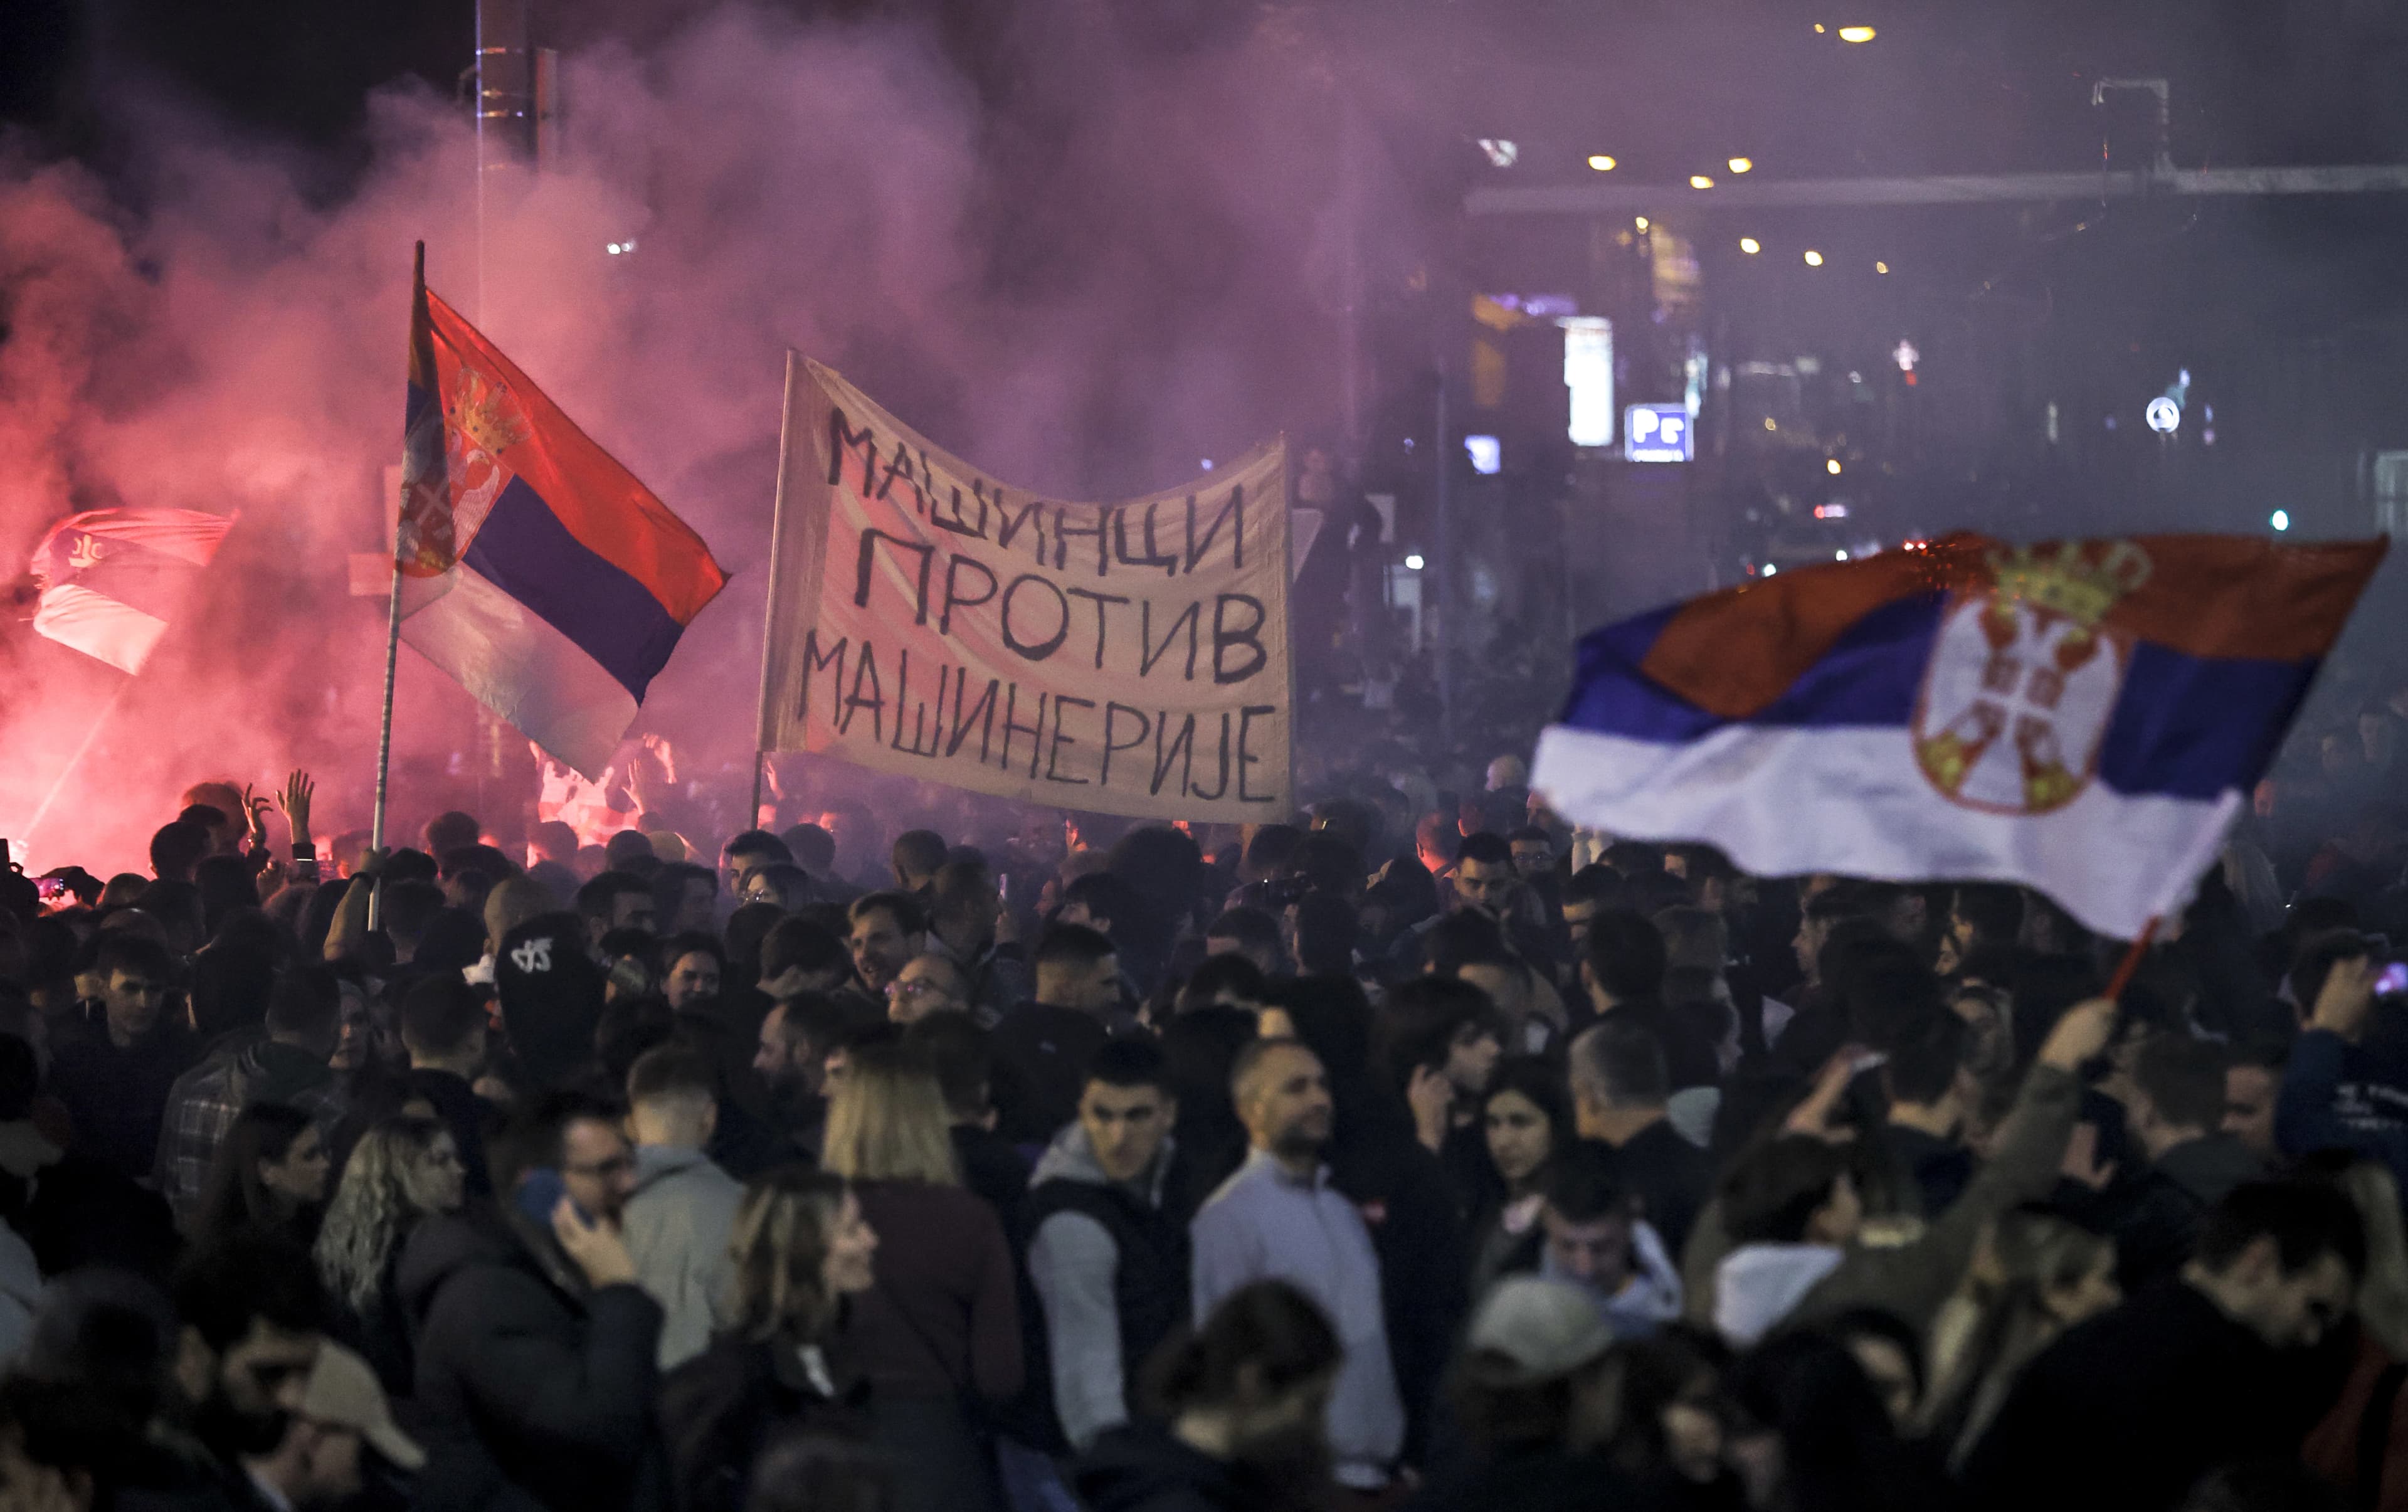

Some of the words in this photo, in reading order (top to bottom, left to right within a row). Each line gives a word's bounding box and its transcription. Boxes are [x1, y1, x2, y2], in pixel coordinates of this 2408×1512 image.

[828, 408, 1244, 576] МАШИНЦИ
[853, 527, 1267, 685] ПРОТИВ
[796, 629, 1276, 803] МАШИНЕРИЈЕ
